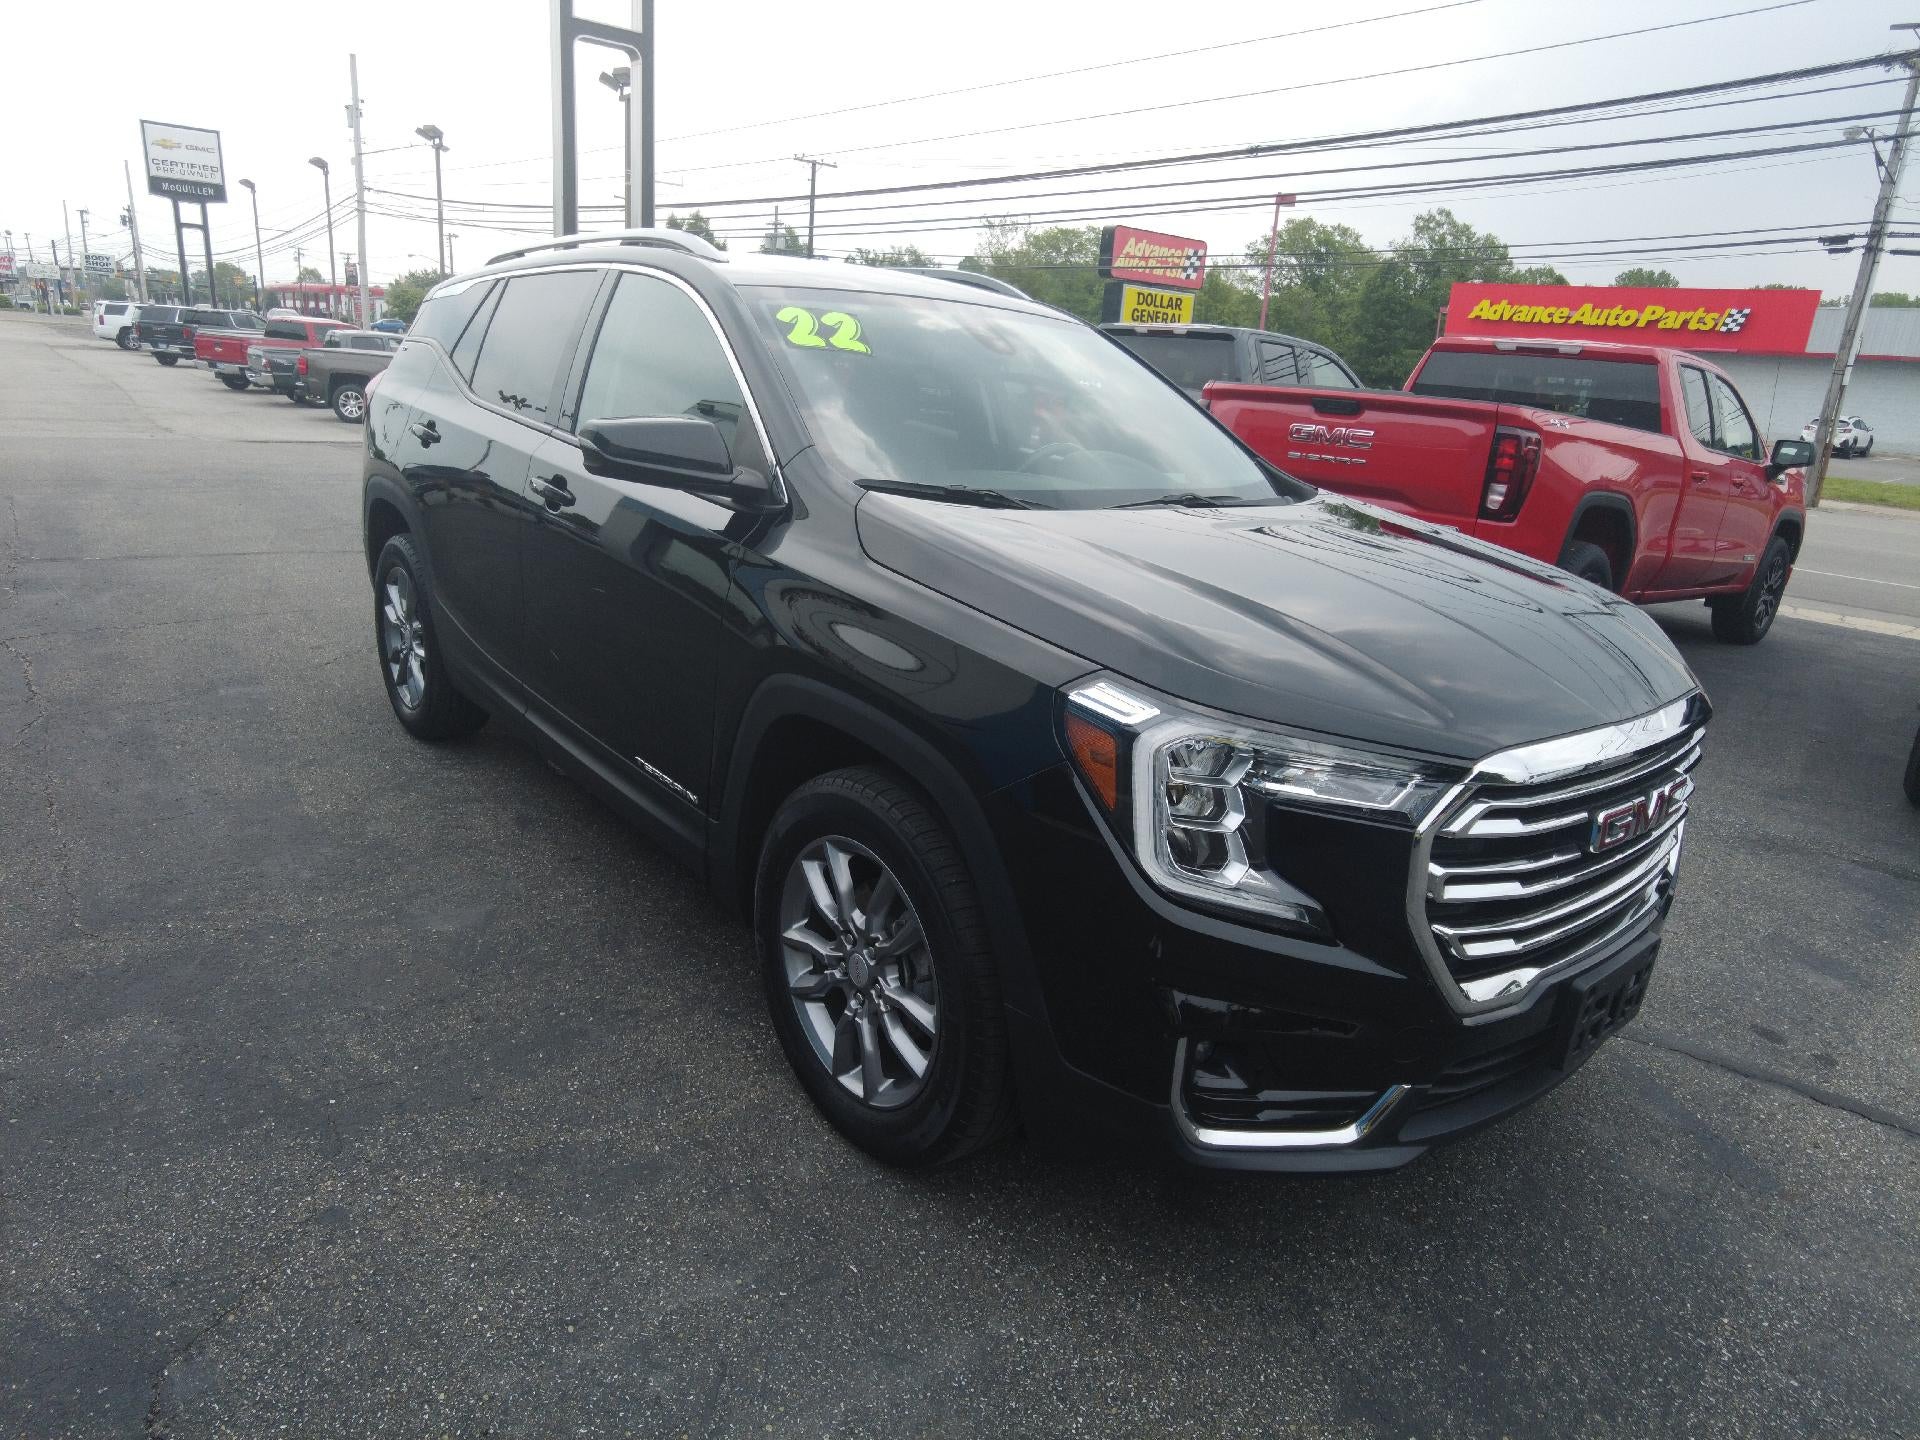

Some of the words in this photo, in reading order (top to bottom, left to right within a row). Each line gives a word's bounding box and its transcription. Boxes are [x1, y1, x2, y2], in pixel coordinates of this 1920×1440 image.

[185, 144, 217, 154] GMC
[152, 158, 219, 173] CERTIFIED
[85, 254, 111, 262] BODY
[1122, 237, 1181, 263] Advance
[85, 260, 112, 268] SHOP
[1136, 292, 1183, 311] DOLLAR
[1131, 308, 1183, 324] GENERAL
[1468, 299, 1569, 324] Advance
[1568, 303, 1639, 327] Auto
[1636, 305, 1719, 331] Parts
[776, 306, 871, 354] 22
[1288, 423, 1375, 449] GMC
[1589, 773, 1692, 853] GMC
